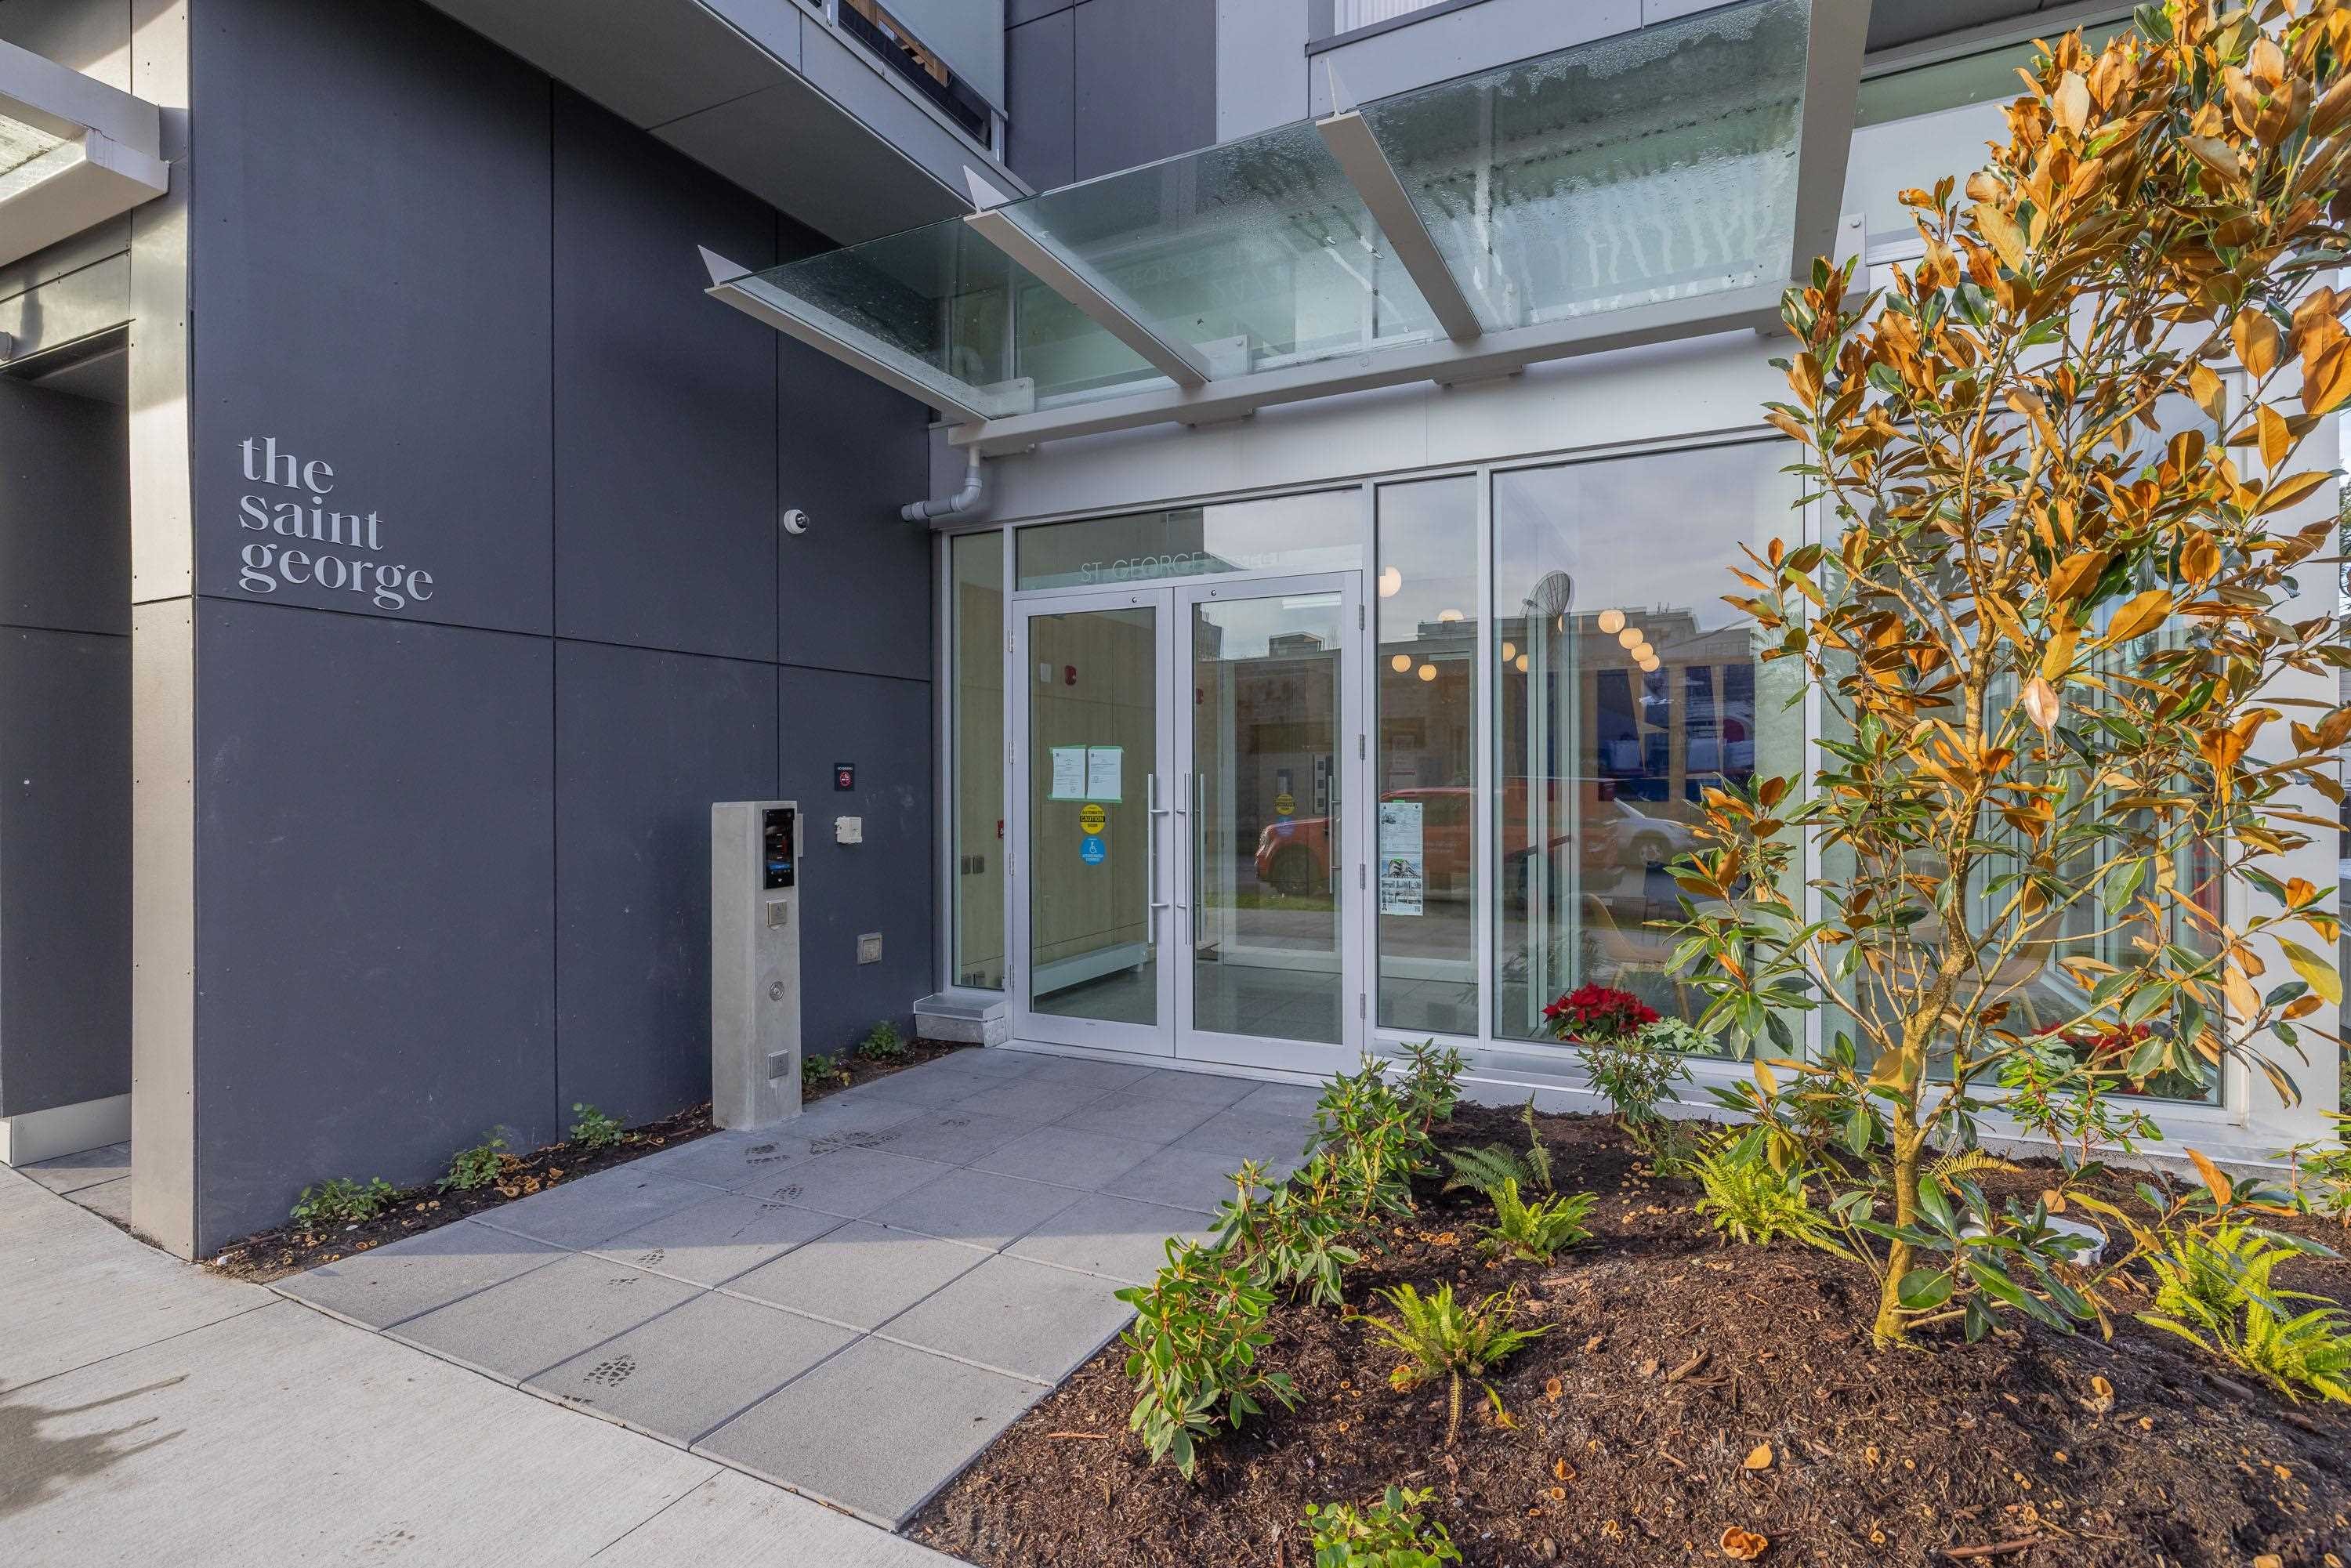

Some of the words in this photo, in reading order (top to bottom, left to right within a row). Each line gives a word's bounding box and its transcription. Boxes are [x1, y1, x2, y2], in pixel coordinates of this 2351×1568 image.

[237, 436, 334, 494] the
[238, 495, 383, 551] saint
[238, 543, 433, 610] george
[1081, 561, 1103, 583] ST
[1112, 551, 1203, 579] GEORGE
